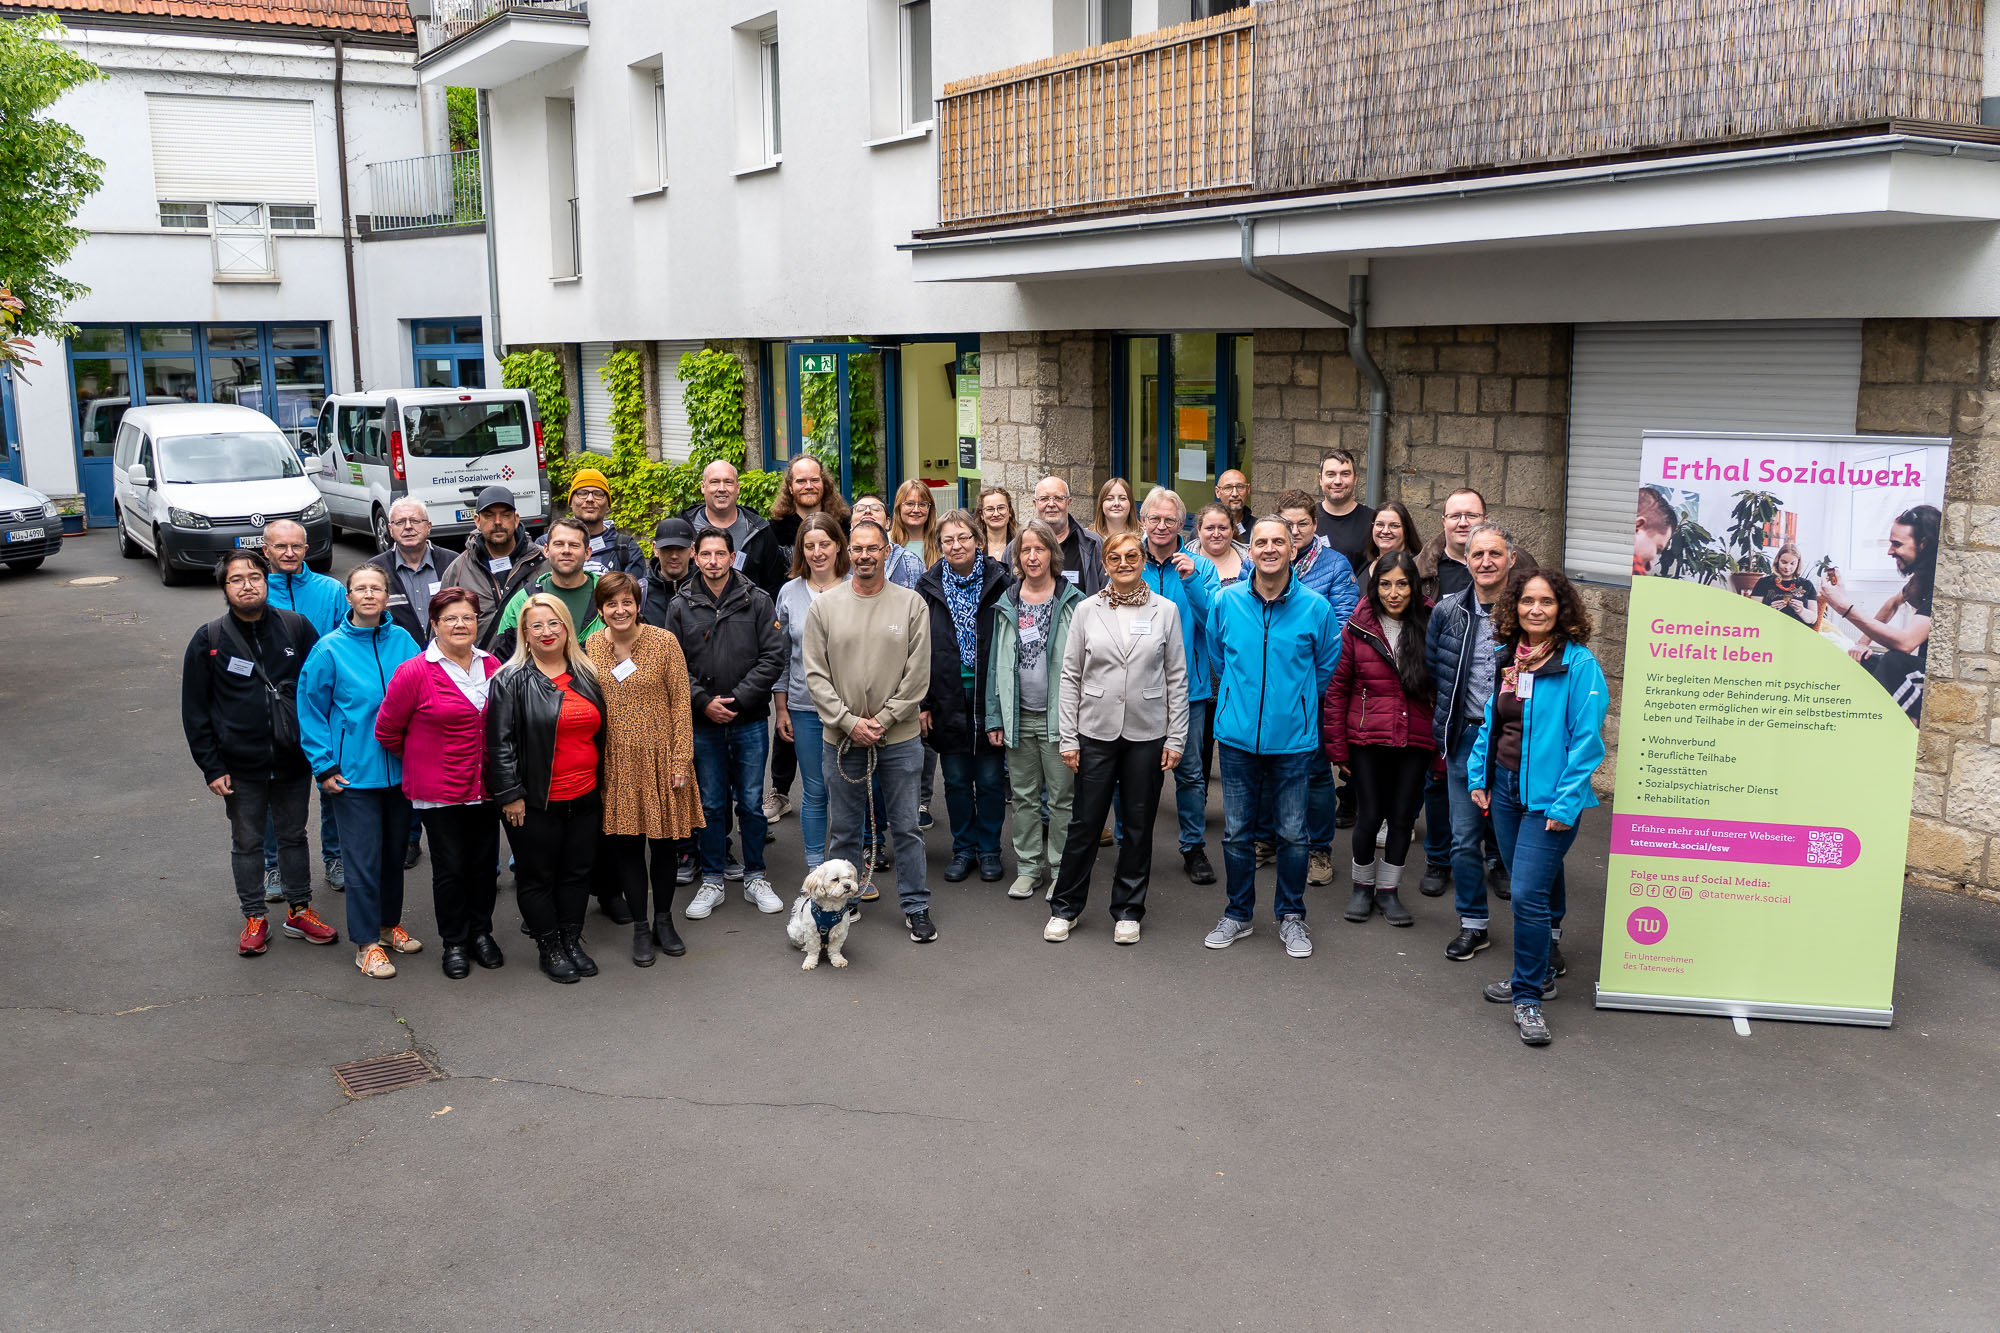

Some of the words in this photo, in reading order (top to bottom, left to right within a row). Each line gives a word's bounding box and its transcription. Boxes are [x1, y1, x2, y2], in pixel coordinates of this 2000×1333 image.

[432, 476, 457, 485] Erthal
[458, 472, 501, 483] Sozialwerk
[1662, 456, 1749, 482] Erthal
[1758, 459, 1921, 487] Sozialwerk
[1651, 618, 1760, 639] Gemeinsam
[1649, 642, 1718, 661] Vielfalt
[1722, 645, 1773, 663] leben
[1646, 673, 1664, 682] Wir
[1666, 673, 1711, 685] begleiten
[1713, 676, 1762, 687] Menschen
[1765, 679, 1782, 688] mit
[1784, 680, 1841, 691] psychischer
[1645, 687, 1699, 699] Erkrankung
[1702, 689, 1725, 699] oder
[1727, 690, 1790, 703] Behinderung.
[1793, 693, 1810, 703] Mit
[1812, 697, 1852, 705] unseren
[1644, 699, 1697, 711] Angeboten
[1699, 703, 1759, 714] ermöglichen
[1761, 706, 1777, 714] wir
[1778, 706, 1793, 716] ein
[1796, 707, 1883, 720] selbstbestimmtes
[1643, 712, 1672, 723] Leben
[1674, 714, 1693, 724] und
[1695, 715, 1735, 726] Teilhabe
[1737, 717, 1746, 726] in
[1748, 718, 1765, 728] der
[1766, 718, 1837, 732] Gemeinschaft:
[1648, 735, 1716, 747] Wohnverbund
[1647, 749, 1695, 761] Berufliche
[1697, 752, 1737, 764] Teilhabe
[1646, 764, 1708, 776] Tagesstätten
[1645, 778, 1745, 793] Sozialpsychiatrischer
[1747, 784, 1778, 796] Dienst
[1644, 793, 1710, 806] Rehabilitation
[1631, 823, 1666, 834] Erfahre
[1667, 826, 1693, 836] mehr
[1694, 828, 1710, 837] auf
[1712, 830, 1747, 839] unserer
[1749, 831, 1795, 842] Webseite:
[1630, 839, 1730, 852] tatenwerk.social/esw
[1630, 869, 1658, 882] Folge
[1660, 874, 1680, 882] uns
[1681, 874, 1700, 883] auf
[1701, 874, 1733, 886] Social
[1735, 877, 1771, 888] Media:
[1698, 889, 1791, 904] @tatenwerk.social
[1624, 951, 1637, 960] Ein
[1638, 952, 1694, 964] Unternehmen
[1623, 962, 1637, 970] des
[1639, 964, 1684, 974] Tatenwerks
